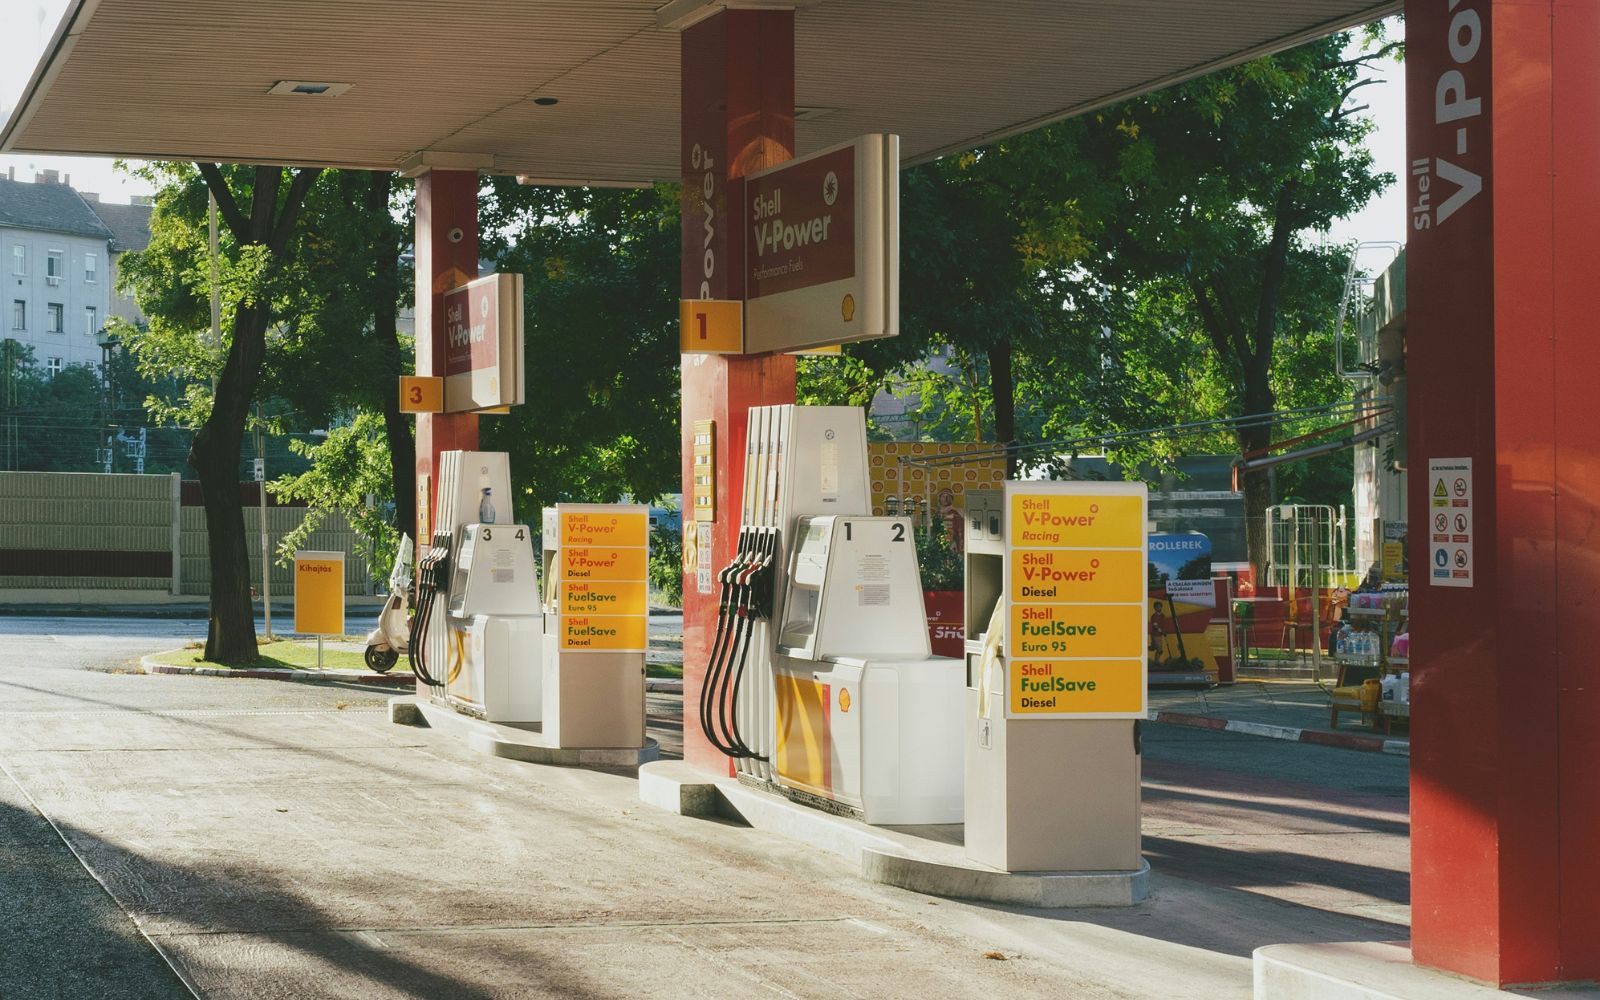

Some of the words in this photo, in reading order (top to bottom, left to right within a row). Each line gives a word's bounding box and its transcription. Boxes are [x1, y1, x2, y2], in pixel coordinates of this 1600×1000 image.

[1436, 0, 1482, 225] V-Po
[1413, 158, 1430, 230] Shell
[753, 188, 781, 220] Shell
[754, 214, 832, 257] V-Power
[788, 256, 804, 274] Fuels
[448, 304, 462, 323] Shell
[696, 313, 707, 340] 1
[448, 324, 486, 348] V-Power
[410, 386, 423, 404] 3
[1022, 500, 1050, 510] Shell
[1022, 512, 1095, 527] V-Power
[483, 528, 492, 541] 3
[515, 529, 524, 541] 4
[568, 524, 615, 533] V-Power
[844, 522, 852, 541] 1
[891, 523, 905, 542] 2
[568, 536, 592, 544] Racing
[1022, 531, 1060, 542] Racing
[1149, 540, 1202, 550] ROLLEREK
[568, 549, 588, 557] Shell
[568, 558, 615, 567] V-Power
[1022, 554, 1053, 566] Shell
[299, 564, 332, 574] Kihajtás
[1023, 567, 1096, 582] V-Power
[568, 592, 616, 601] FuelSave
[1022, 586, 1057, 597] Diesel
[1022, 608, 1052, 620] Shell
[568, 618, 588, 626] Shell
[568, 627, 616, 636] FuelSave
[1022, 622, 1097, 636] FuelSave
[1022, 642, 1048, 652] Euro
[1051, 642, 1067, 652] 95
[1022, 664, 1052, 676] Shell
[1021, 677, 1096, 692] FuelSave
[1022, 697, 1056, 708] Diesel
